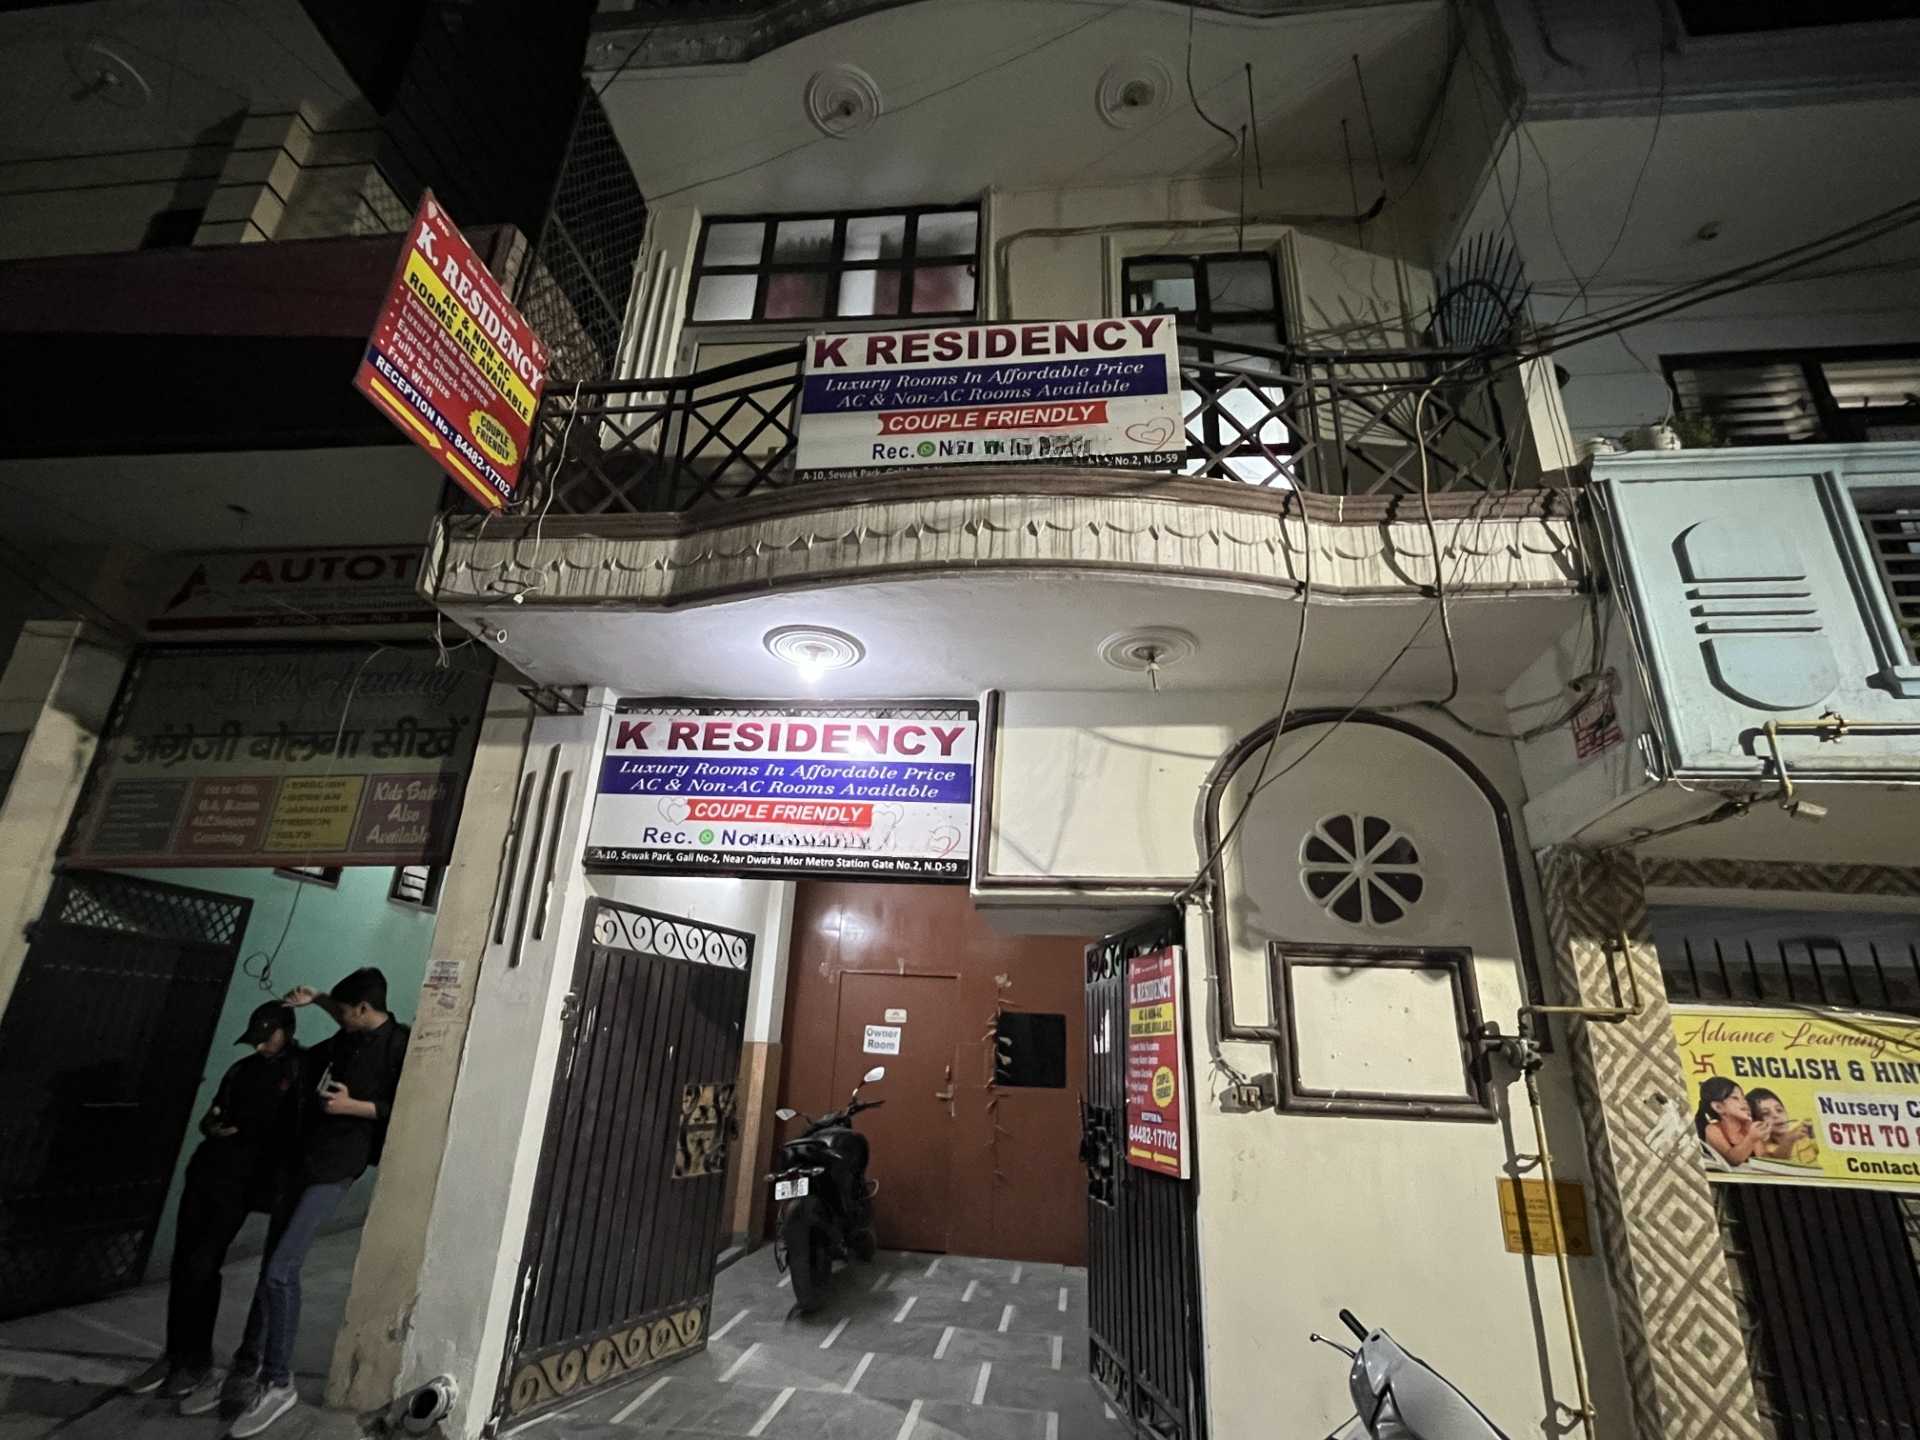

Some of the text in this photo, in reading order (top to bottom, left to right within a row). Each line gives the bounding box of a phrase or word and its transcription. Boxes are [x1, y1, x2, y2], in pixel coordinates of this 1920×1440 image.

[407, 291, 437, 332] Lowest
[442, 255, 543, 391] RESIDENCY
[397, 318, 432, 361] Express
[409, 272, 453, 330] ROOMS
[455, 328, 477, 359] ARE
[478, 355, 529, 420] AVAILABLE
[443, 294, 511, 383] AC & NON-AC
[814, 318, 1163, 368] K RESIDENCY
[387, 345, 409, 373] Free
[392, 332, 451, 399] Fully Sanitize
[402, 305, 432, 344] Luxury
[461, 371, 489, 408] Service
[825, 361, 1145, 392] Luxury Rooms In Affordable Price
[837, 378, 1131, 408] AC & Non-AC Rooms Available
[376, 354, 435, 422] RECEPTION
[454, 434, 511, 497] 84482-17702
[480, 415, 510, 447] COUPLE
[888, 405, 1096, 431] COUPLE FRIENDLY
[476, 426, 510, 461] FRIENDLY
[872, 443, 915, 460] Rec.
[249, 720, 365, 763] बोलना
[371, 716, 471, 760] सीखें
[615, 721, 966, 756] K RESIDENCY
[620, 761, 956, 781] Luxury Rooms In Affordable Price
[373, 781, 403, 801] Kids
[630, 778, 939, 798] AC & Non-AC Rooms Available
[387, 802, 420, 823] Also
[694, 802, 864, 822] COUPLE FRIENDLY
[643, 827, 692, 845] Rec.
[621, 851, 649, 861] Sewak
[652, 852, 674, 862] Park,
[676, 852, 694, 862] Gali
[696, 853, 720, 864] No-2,
[722, 854, 745, 864] Near
[747, 854, 782, 865] Dwarka
[783, 856, 804, 866] Mor
[805, 856, 834, 867] Metro
[836, 857, 870, 869] Station
[872, 859, 895, 870] Gate
[896, 860, 922, 872] No.2,
[924, 861, 958, 872] N.D-59
[866, 1027, 898, 1038] Owner
[867, 1039, 896, 1050] Room
[1680, 1019, 1776, 1047] Advance
[1781, 1022, 1887, 1059] Learning
[1731, 1055, 1841, 1081] ENGLISH
[1847, 1060, 1866, 1082] &
[1818, 1096, 1899, 1121] Nursery
[1129, 1124, 1177, 1150] 84482-17702
[1828, 1122, 1875, 1147] 6TH
[1879, 1125, 1910, 1148] TO
[1847, 1157, 1920, 1176] Contact
